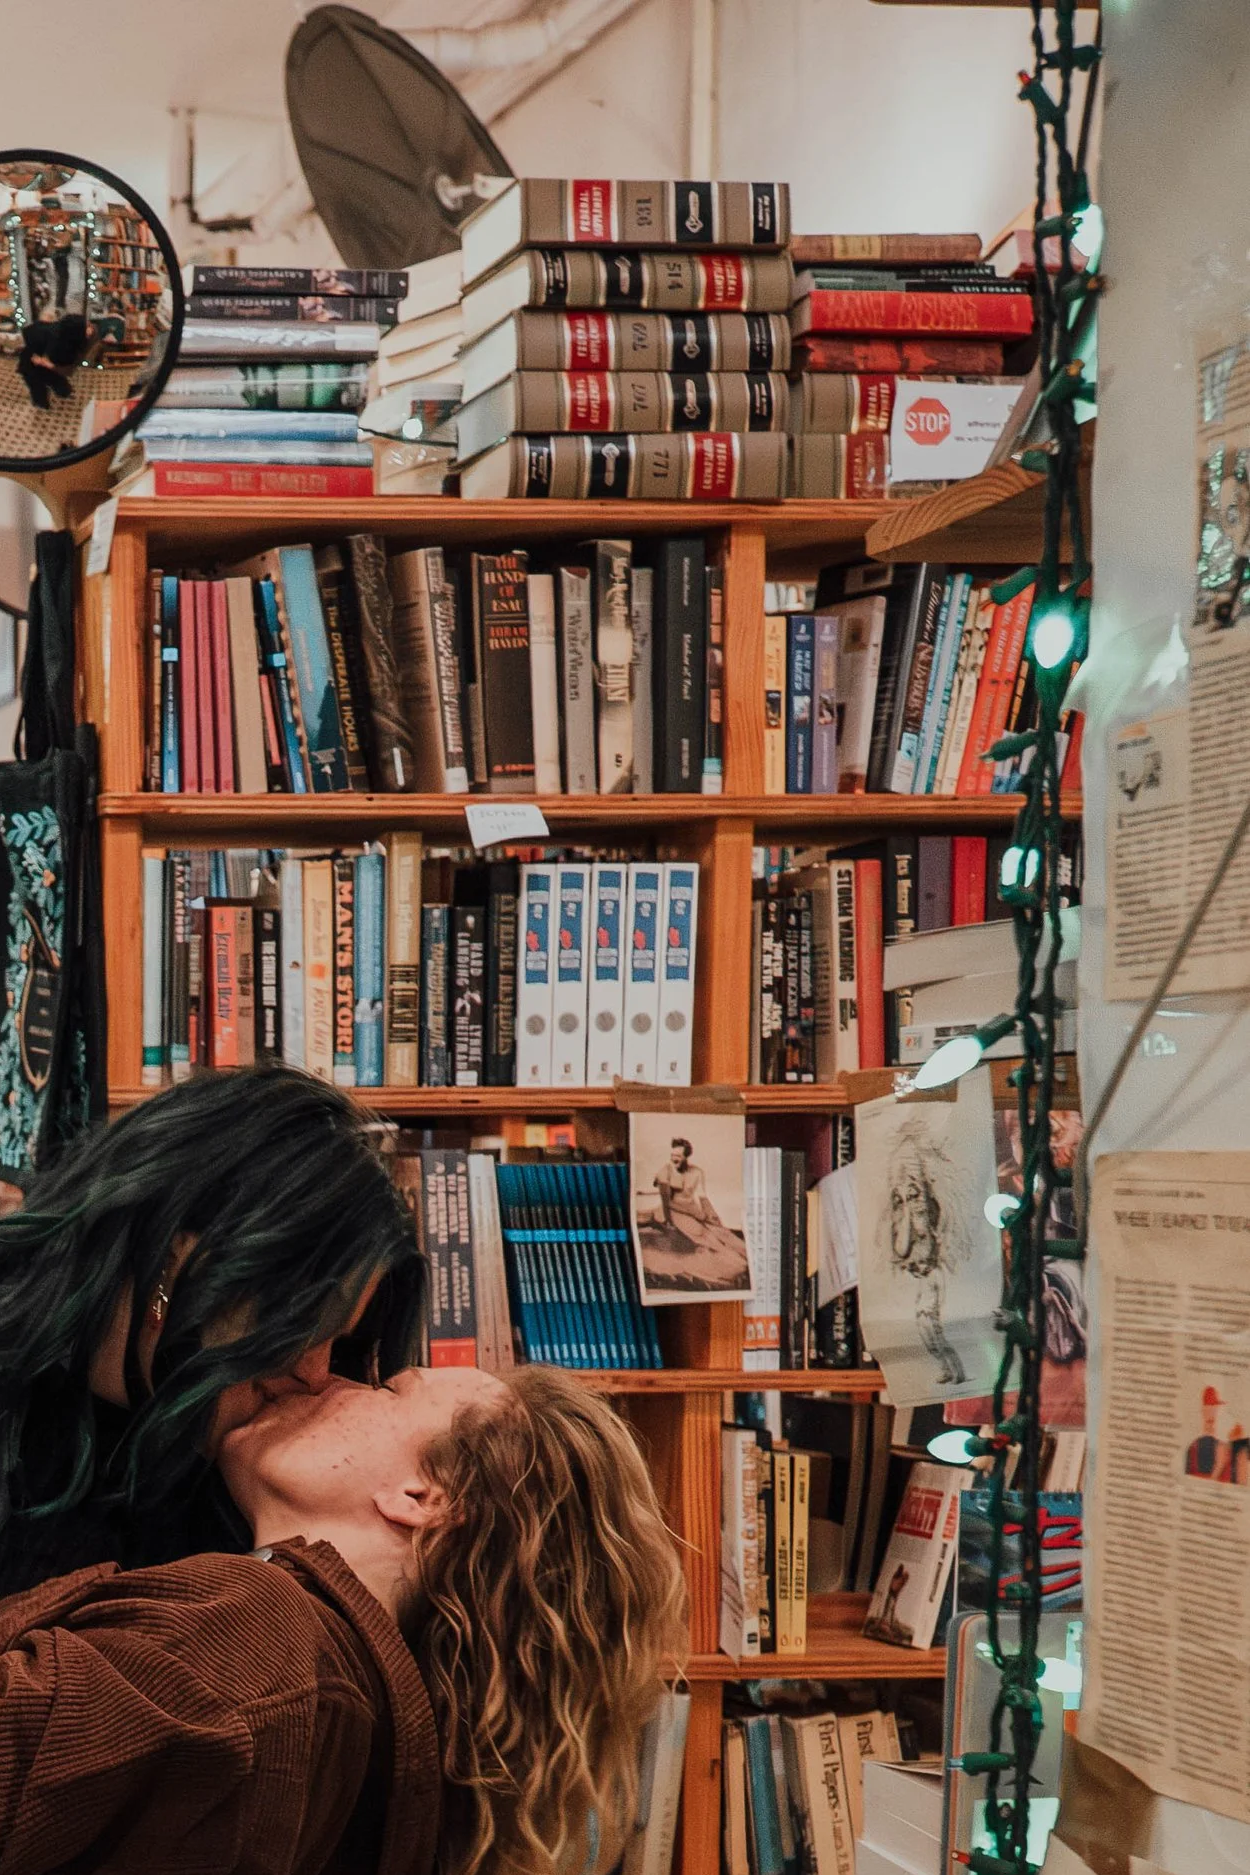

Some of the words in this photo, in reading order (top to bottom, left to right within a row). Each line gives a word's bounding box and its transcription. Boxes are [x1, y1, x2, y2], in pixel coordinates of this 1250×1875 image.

[579, 190, 590, 232] FEDERAL
[591, 186, 604, 237] SUPPLEMENT
[667, 262, 683, 290] 514
[577, 319, 587, 357] FEDERAL
[590, 318, 600, 363] SUPPLEMENT
[577, 378, 587, 418] FEDERAL
[590, 374, 600, 424] SUPPLEMENT
[905, 411, 950, 433] STOP
[702, 438, 715, 490] SUPPLEMENT
[716, 442, 728, 484] FEDERAL
[483, 571, 528, 585] HAND
[495, 556, 518, 570] THE
[492, 599, 522, 612] ESAU
[498, 585, 514, 597] OF
[328, 606, 340, 627] The
[330, 632, 350, 700] DESPERATE
[342, 705, 359, 753] HOURS
[837, 868, 853, 918] STORM
[336, 881, 354, 968] MAN'S
[498, 894, 515, 971] EXTREME
[455, 932, 469, 987] LANDING
[469, 942, 483, 977] HARD
[786, 946, 798, 971] JACK
[839, 920, 855, 982] WARNING
[390, 964, 419, 986] THE
[786, 972, 799, 1018] HIGGINS
[498, 974, 515, 1056] REMEDIES
[456, 1016, 469, 1072] HEITMAN
[469, 1023, 482, 1062] LYNNE
[447, 1173, 458, 1193] TO
[437, 1175, 448, 1245] FAREWELL
[457, 1175, 470, 1245] FAREWELL
[778, 1549, 788, 1601] OUTSIDERS
[794, 1549, 806, 1601] OUTSIDERS
[818, 1720, 836, 1758] First
[856, 1720, 875, 1757] First
[820, 1761, 841, 1810] Papers
